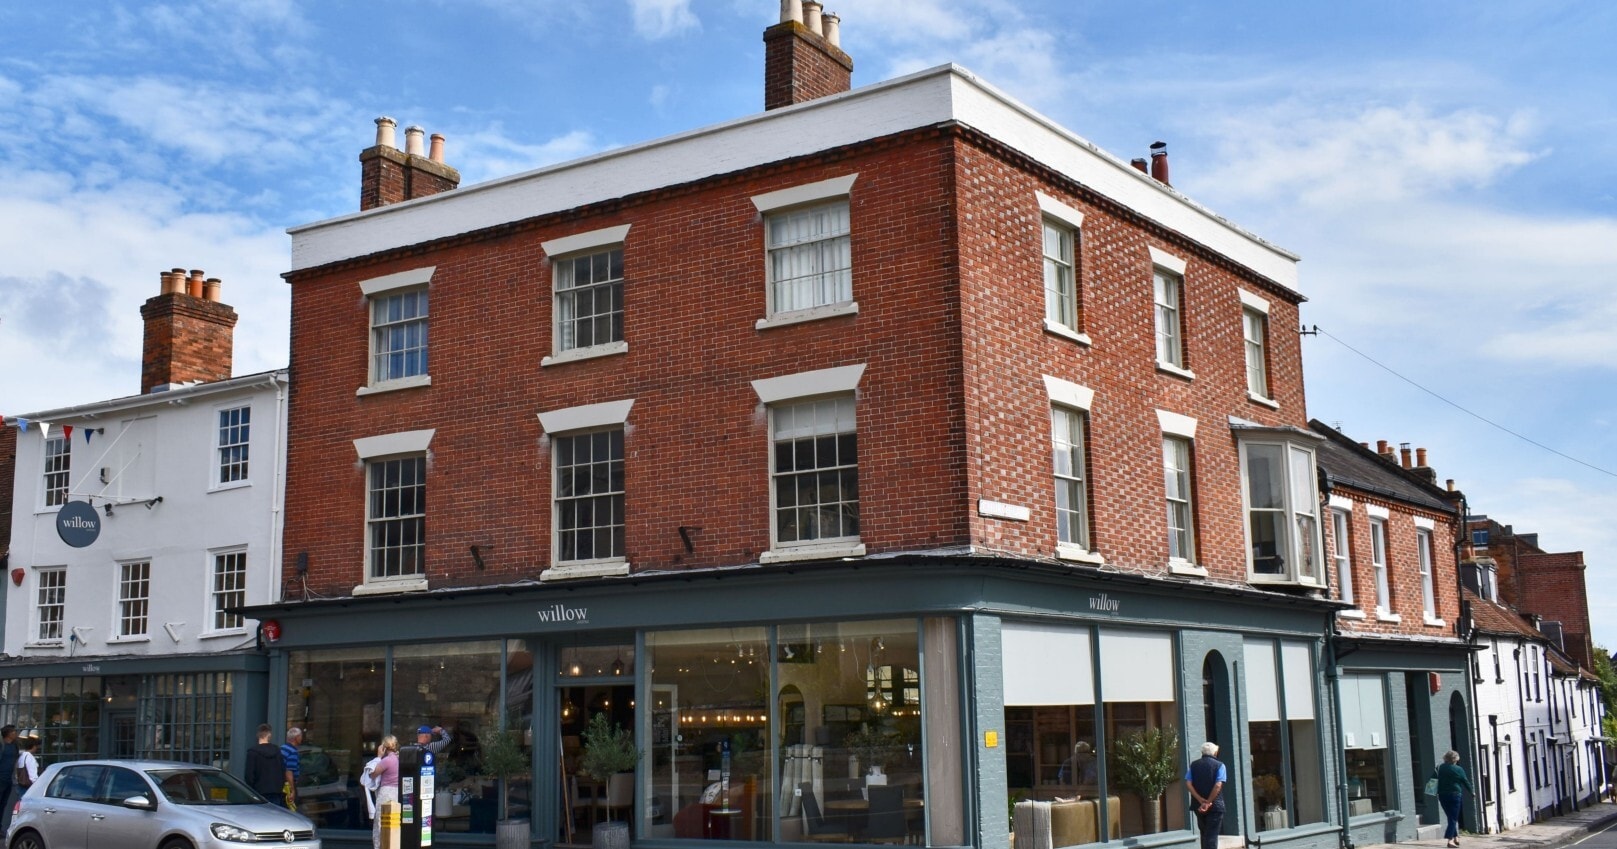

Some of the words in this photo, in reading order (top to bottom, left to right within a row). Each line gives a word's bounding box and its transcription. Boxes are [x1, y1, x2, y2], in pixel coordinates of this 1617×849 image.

[63, 516, 96, 528] willow
[1089, 593, 1120, 611] willow
[537, 604, 588, 623] willow
[82, 663, 101, 672] willow
[425, 754, 431, 764] P
